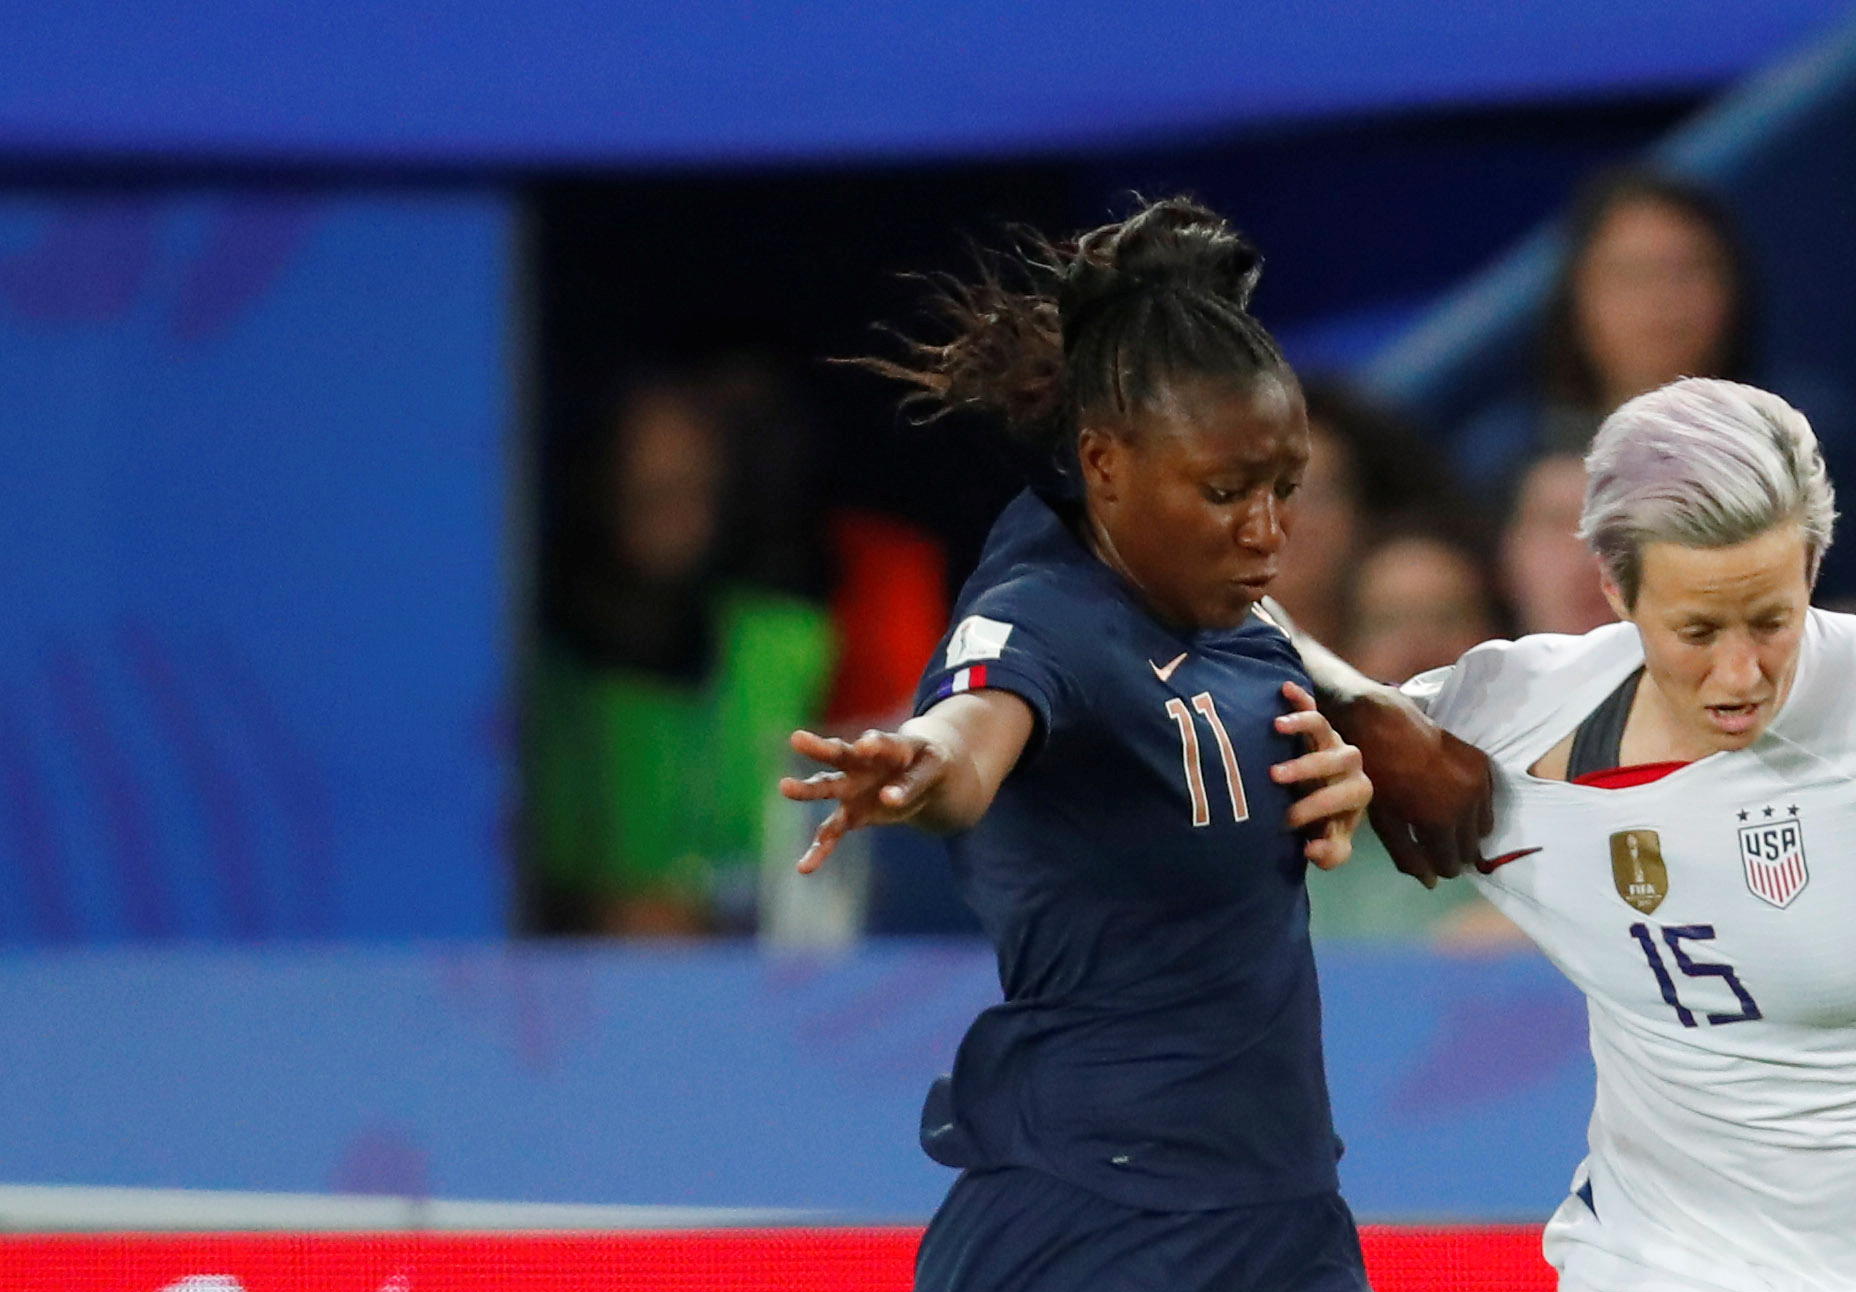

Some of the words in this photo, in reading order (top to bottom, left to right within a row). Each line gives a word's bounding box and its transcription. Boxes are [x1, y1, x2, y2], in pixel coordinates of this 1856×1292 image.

[1165, 691, 1249, 827] 11
[1745, 827, 1796, 861] USA
[1629, 923, 1763, 1028] 15
